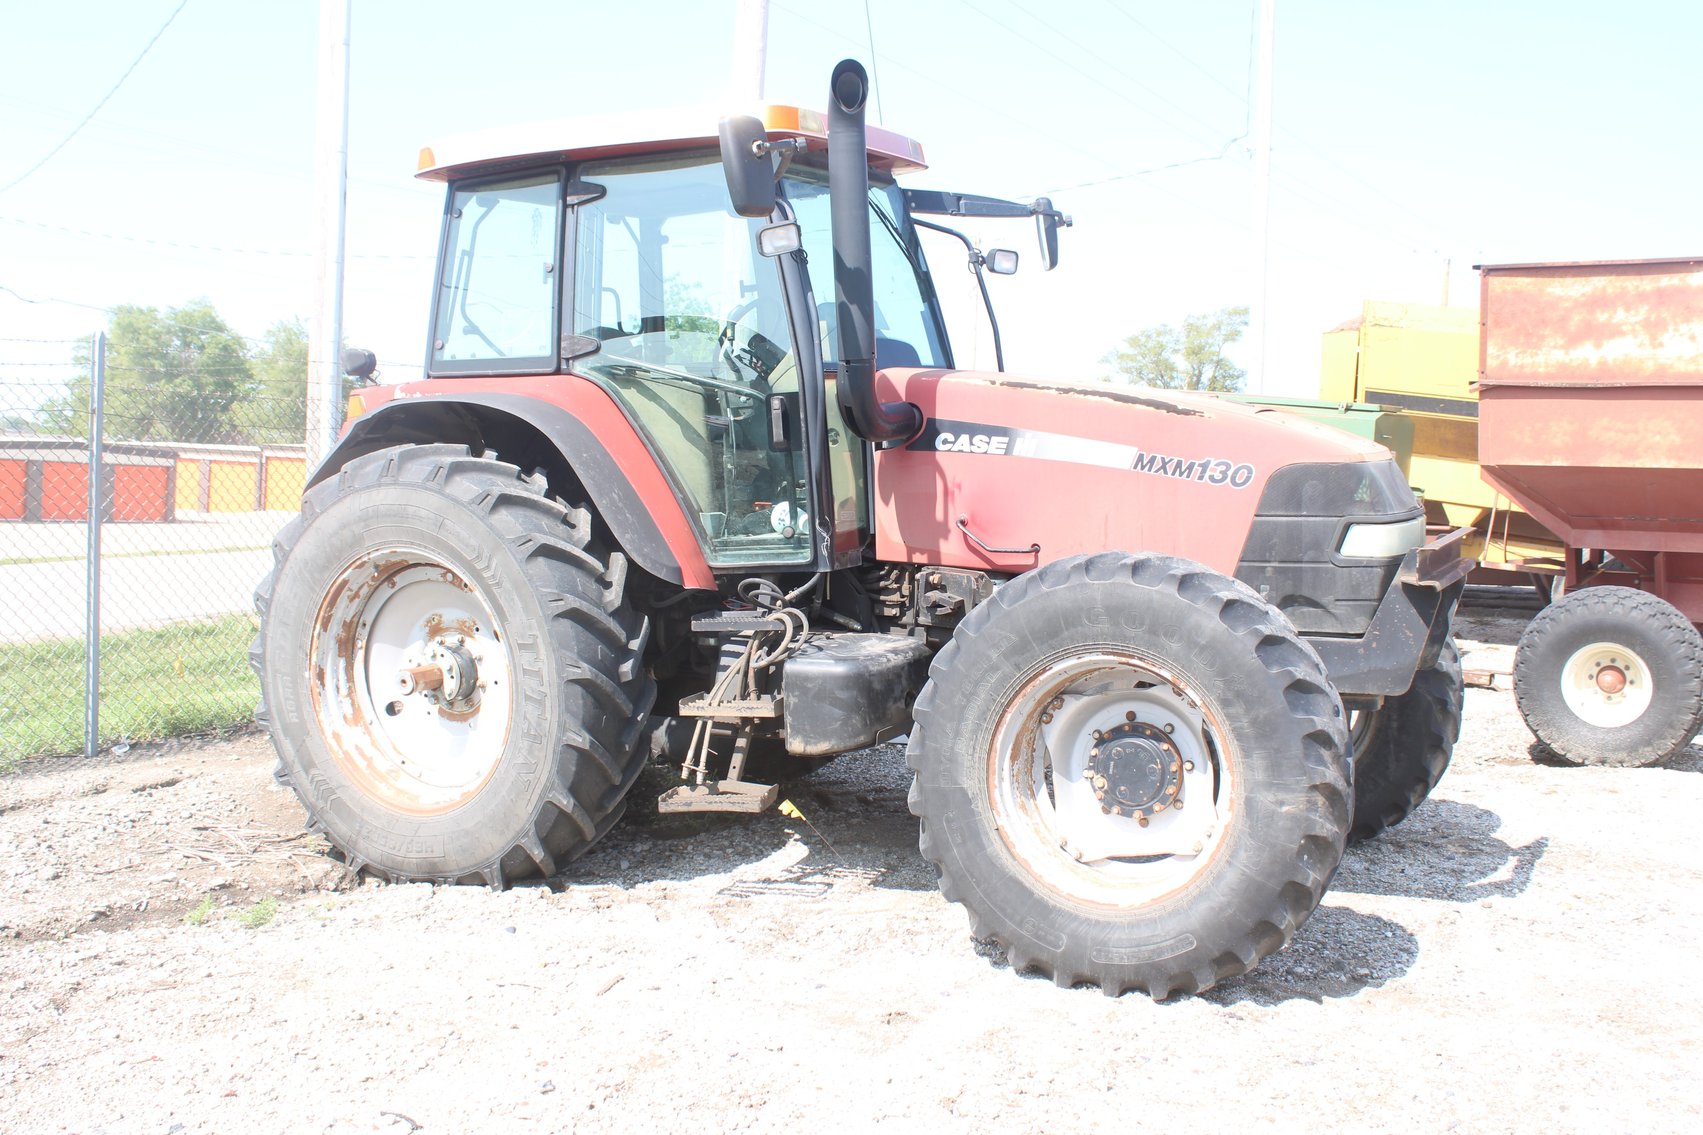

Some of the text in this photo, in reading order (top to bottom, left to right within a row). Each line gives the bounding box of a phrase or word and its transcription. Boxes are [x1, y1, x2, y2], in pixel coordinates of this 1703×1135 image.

[935, 432, 1009, 455] CASE
[1131, 451, 1255, 489] MXM130
[512, 634, 548, 792] TITAN
